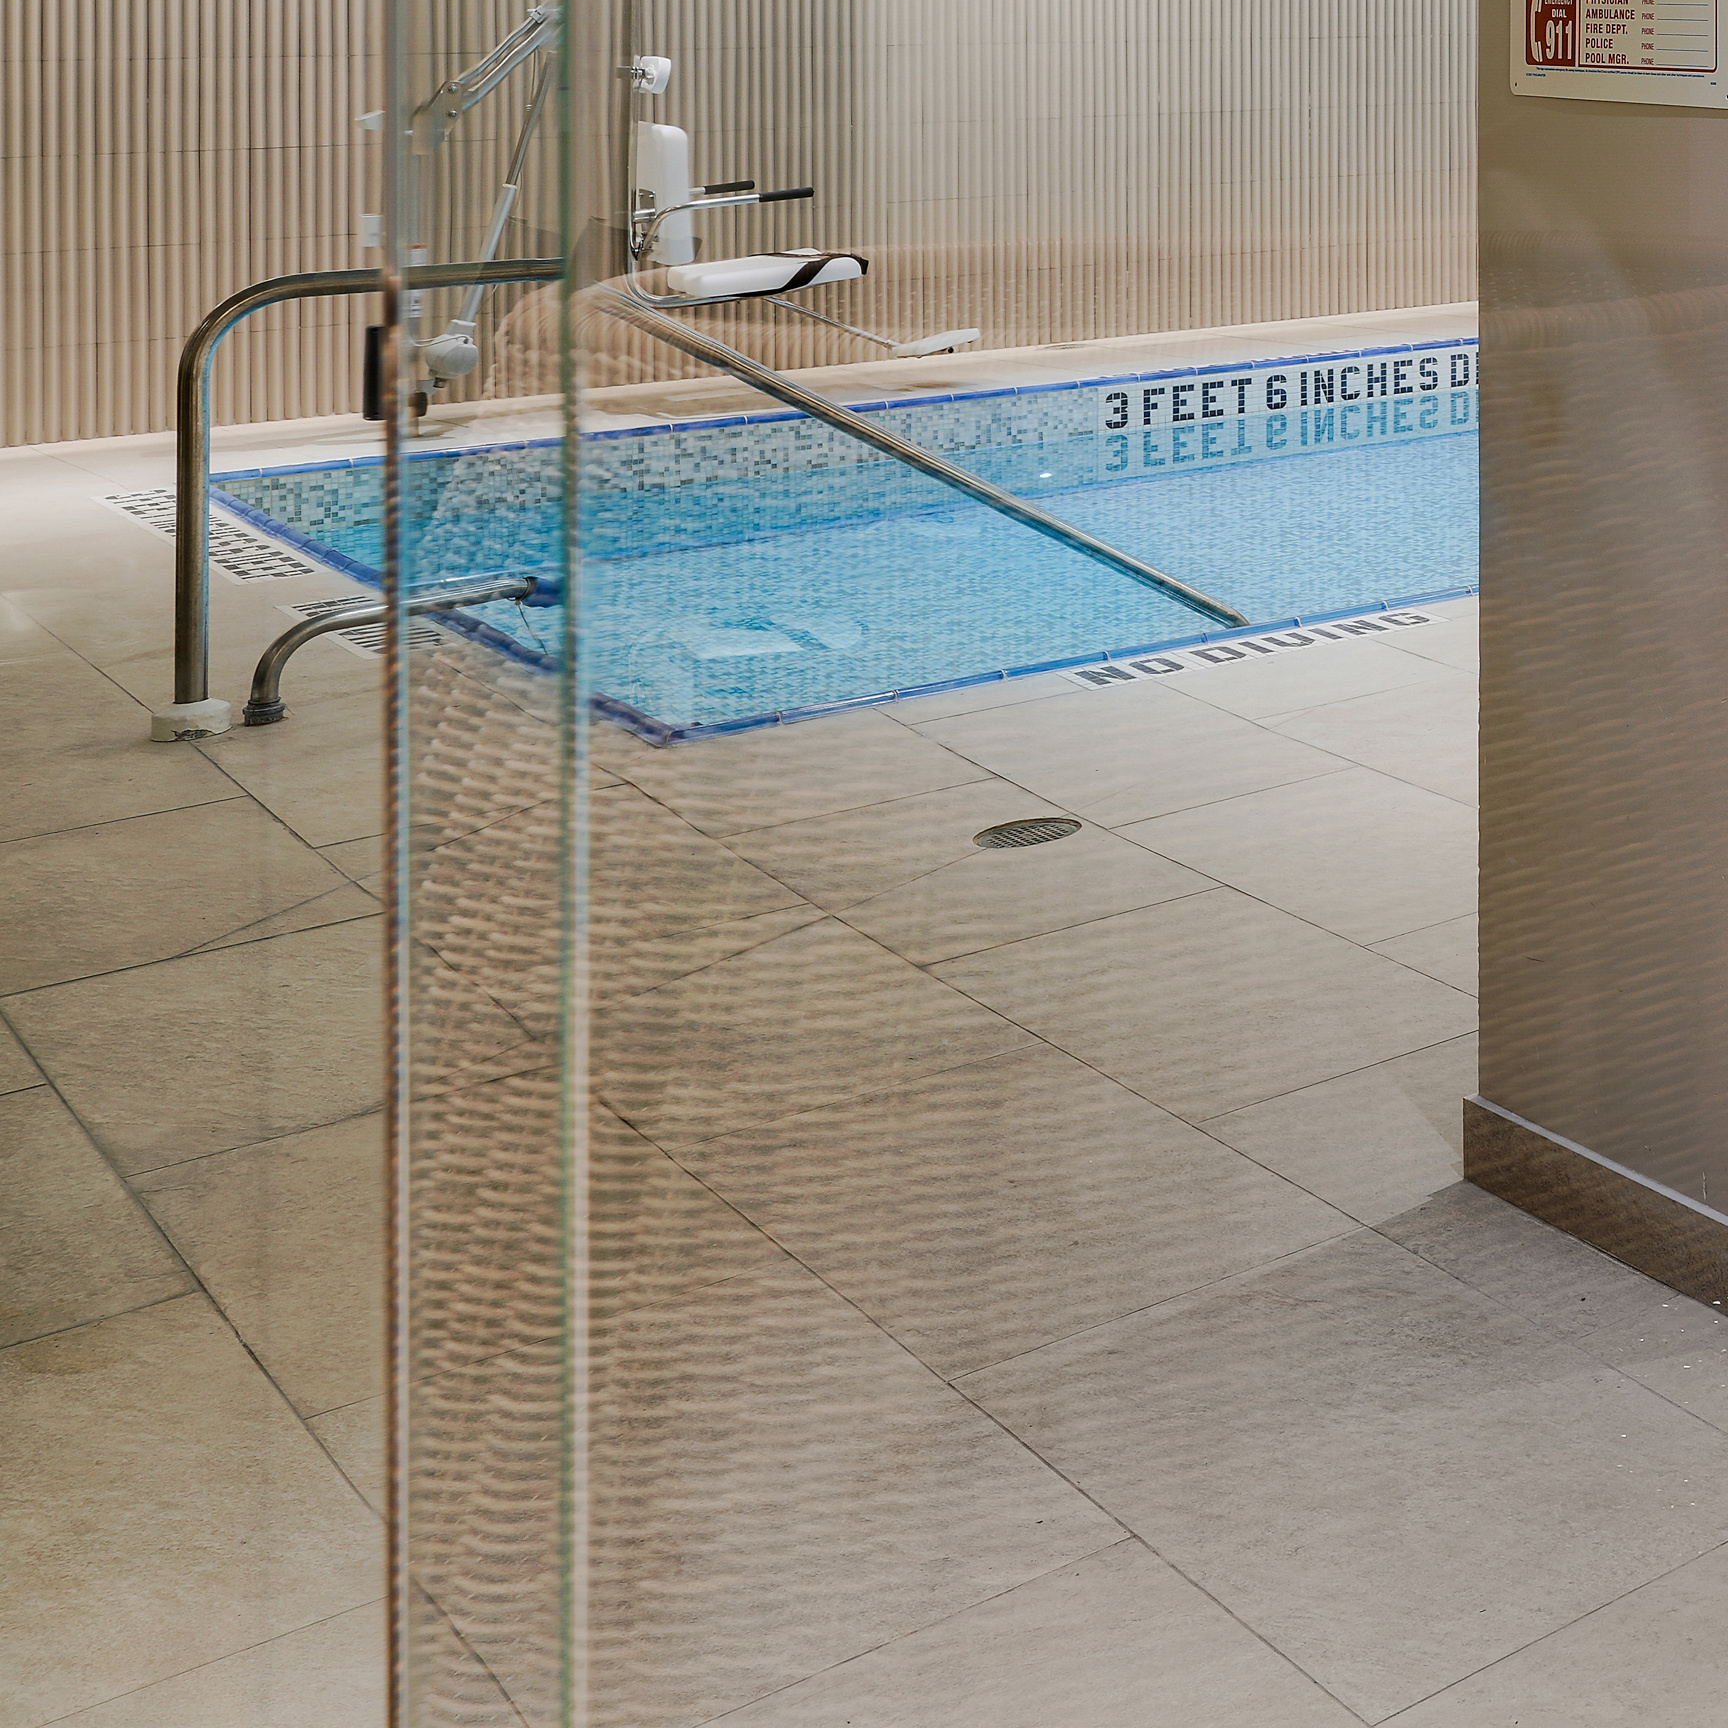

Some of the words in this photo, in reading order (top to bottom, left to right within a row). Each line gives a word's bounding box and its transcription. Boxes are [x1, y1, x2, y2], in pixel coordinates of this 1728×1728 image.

[1552, 9, 1567, 18] DIAL
[1585, 9, 1635, 20] AMBULANCE
[1585, 24, 1603, 34] FIRE
[1606, 24, 1628, 34] DEPT.
[1545, 20, 1572, 60] 911
[1585, 38, 1613, 49] POLICE
[1585, 53, 1605, 64] POOL
[1608, 54, 1629, 65] MGR.
[1105, 392, 1129, 430] 3
[1143, 377, 1252, 426] FEET
[1266, 374, 1288, 410] 6
[1300, 356, 1439, 406] INCHES
[1074, 656, 1185, 685] NO
[1188, 611, 1430, 665] DIVING
